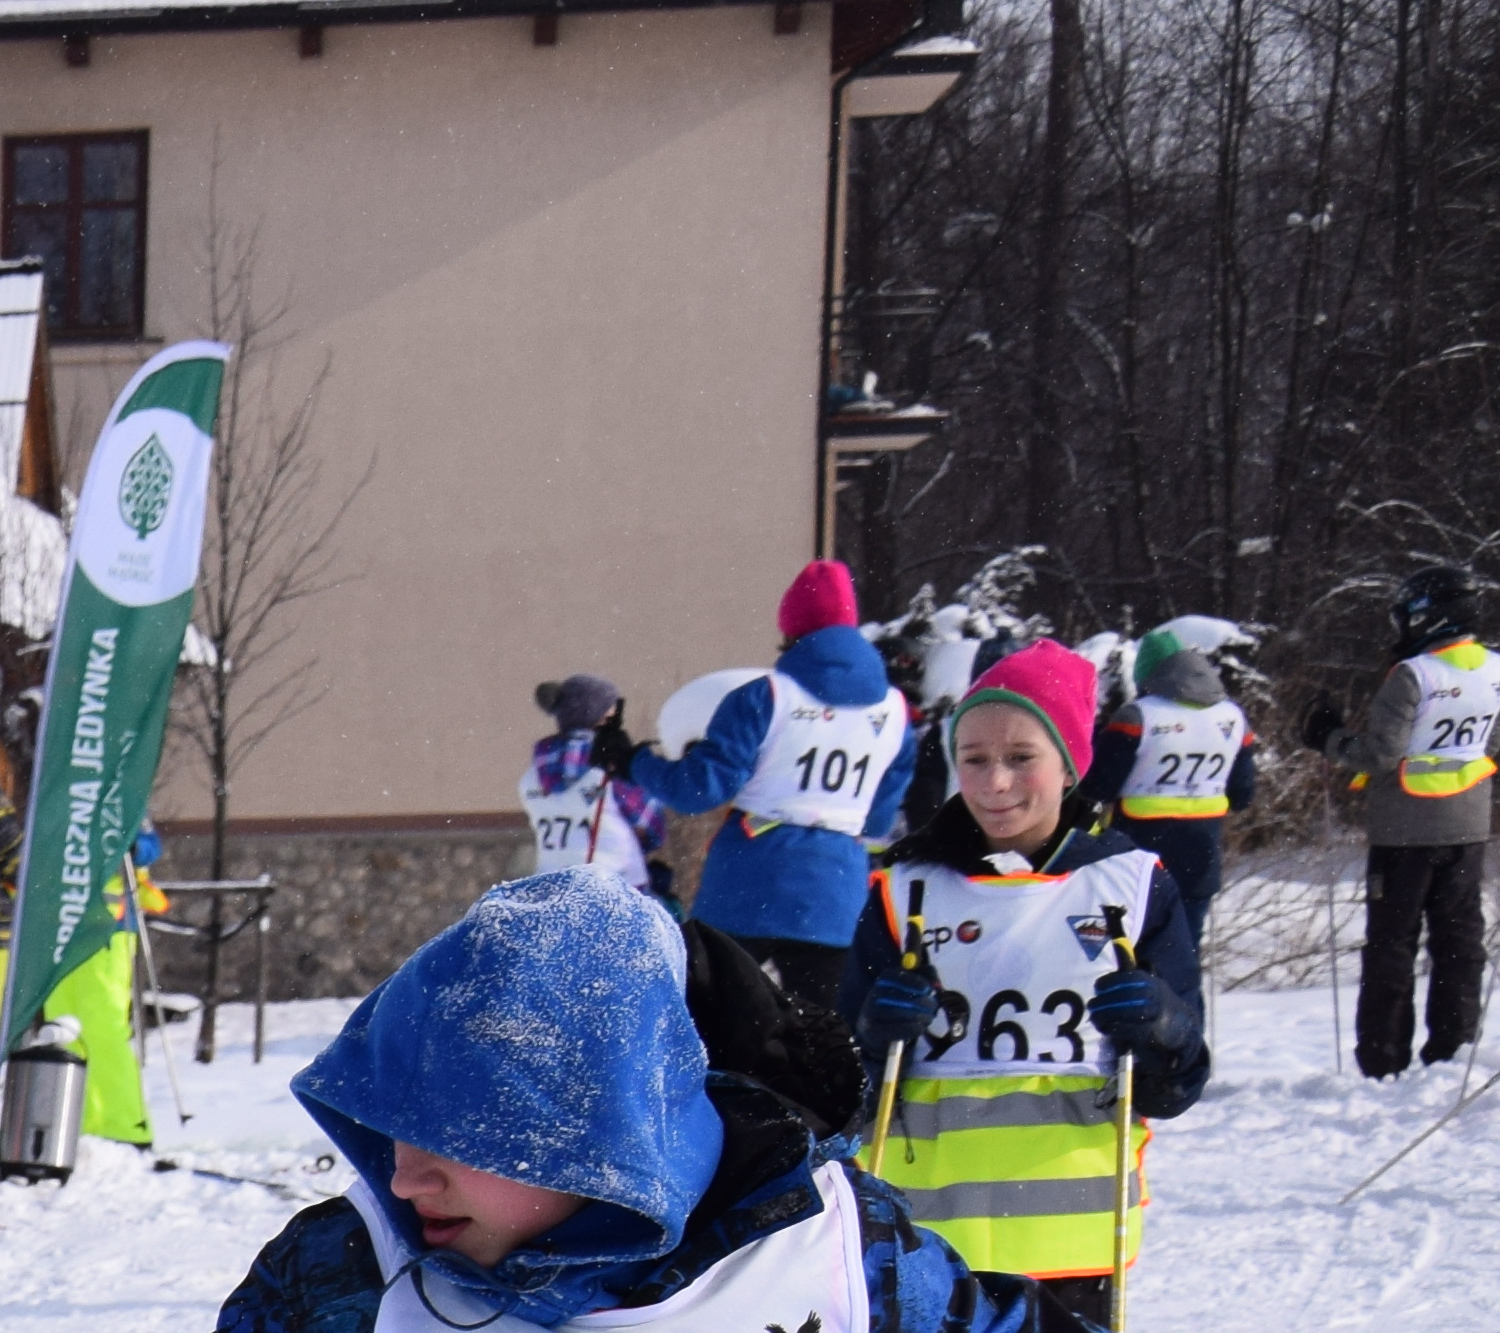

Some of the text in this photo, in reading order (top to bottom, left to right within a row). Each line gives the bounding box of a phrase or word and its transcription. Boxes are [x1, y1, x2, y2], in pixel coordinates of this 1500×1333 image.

[71, 627, 120, 773] JEDYNKA
[1428, 714, 1494, 752] 267
[795, 746, 870, 798] 101
[1156, 753, 1225, 786] 272
[100, 730, 137, 860] OZN
[923, 925, 953, 953] cp
